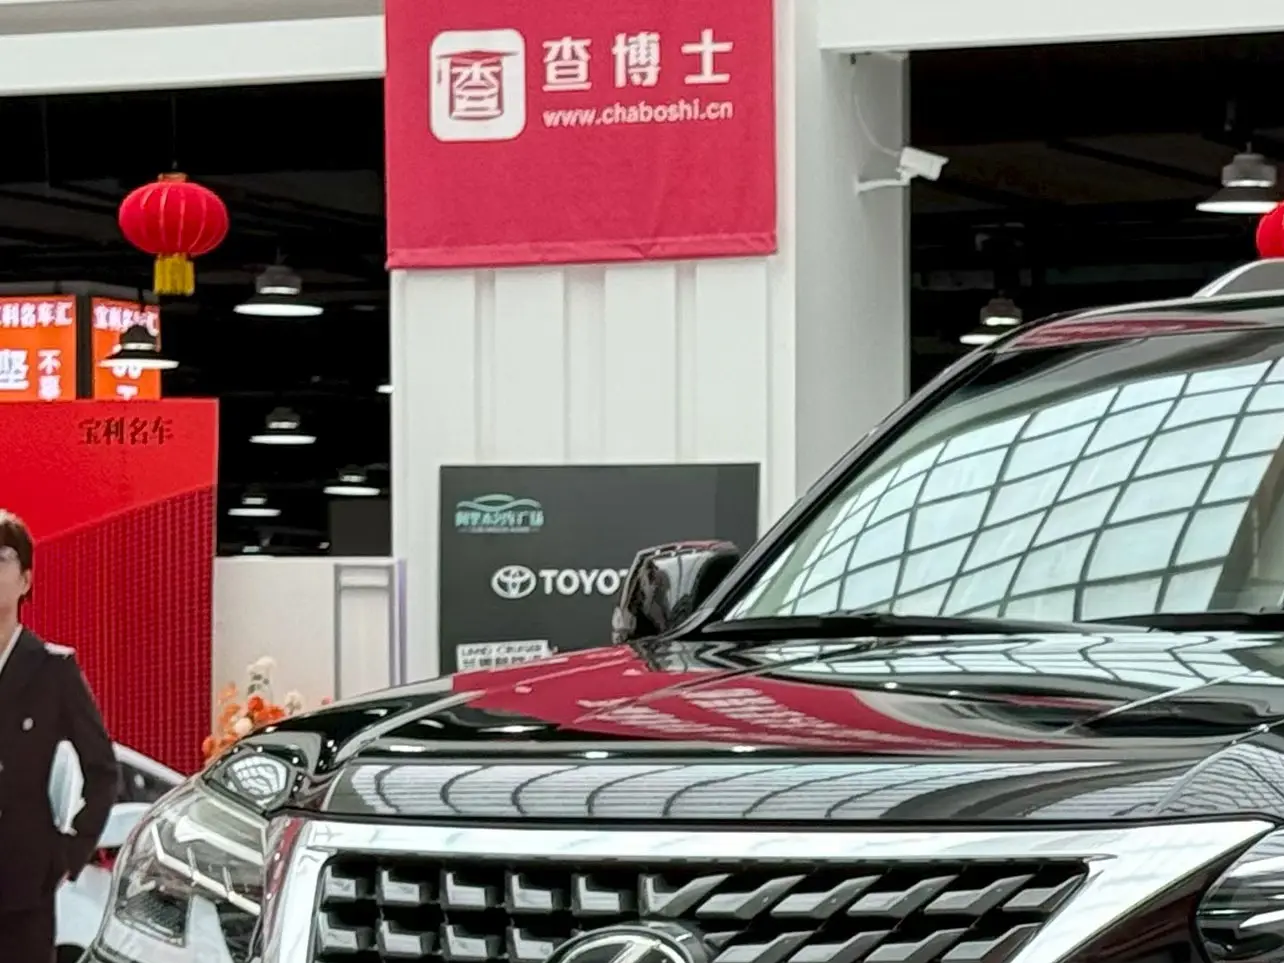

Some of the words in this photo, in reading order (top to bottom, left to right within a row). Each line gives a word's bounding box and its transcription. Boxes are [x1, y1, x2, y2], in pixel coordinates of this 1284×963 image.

[542, 28, 734, 92] 查博士
[542, 98, 734, 128] www.chaboshi.cn
[0, 302, 73, 328] 利名车汇
